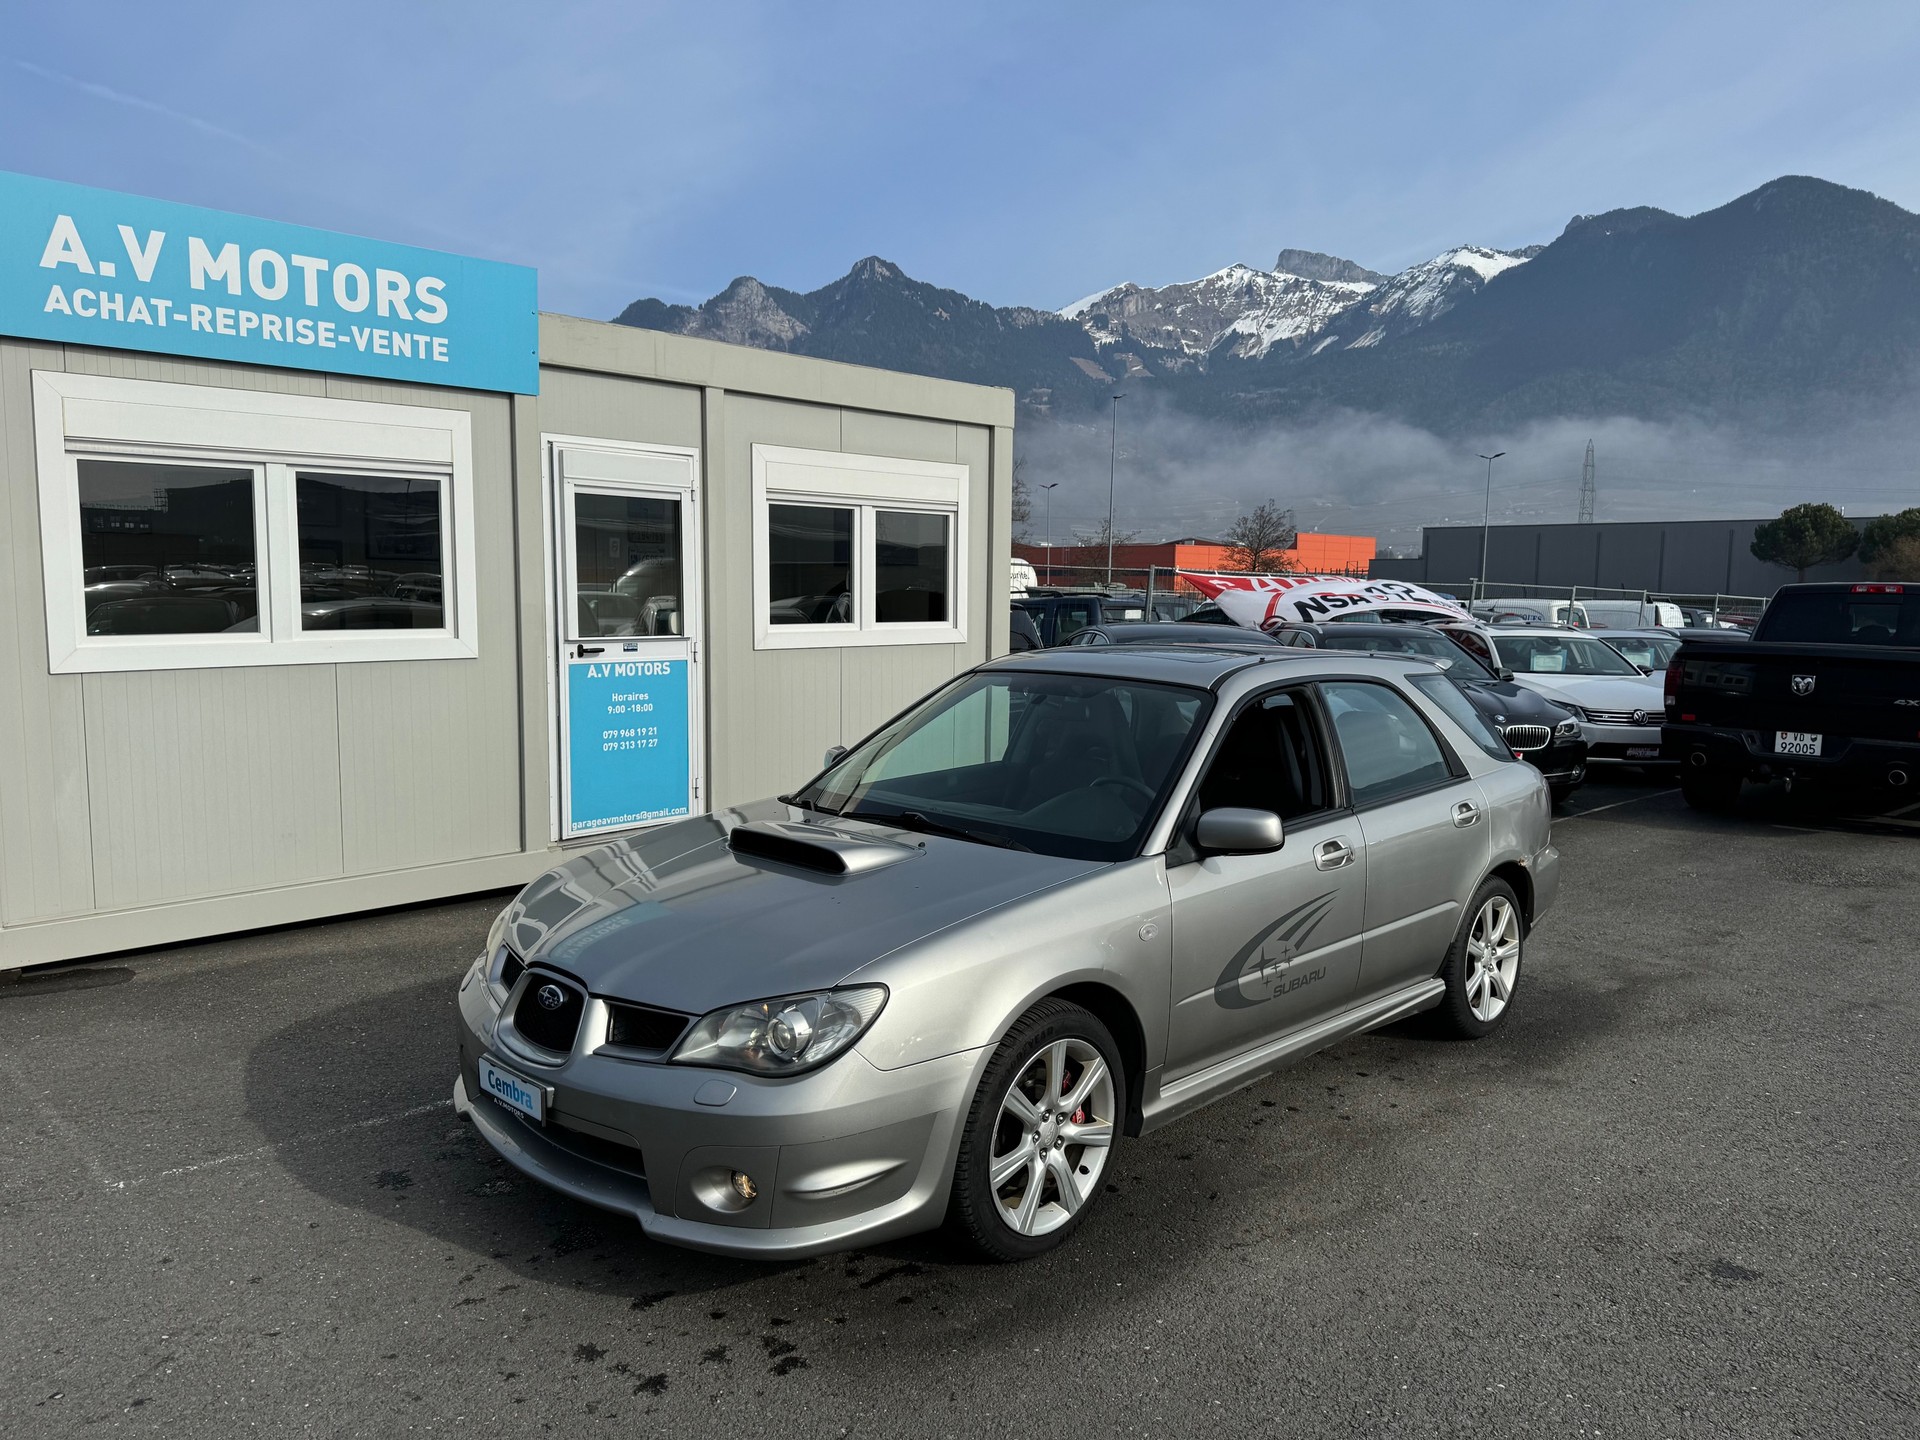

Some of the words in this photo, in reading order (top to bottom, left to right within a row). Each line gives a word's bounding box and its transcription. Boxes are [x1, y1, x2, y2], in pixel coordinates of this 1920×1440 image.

[39, 214, 166, 282] A.V
[188, 236, 449, 324] MOTORS
[43, 284, 450, 363] ACHAT-REPRISE-VENTE
[587, 664, 611, 678] A.V
[615, 662, 671, 677] MOTORS
[612, 692, 649, 702] Horaires
[607, 705, 626, 714] 9:00
[603, 730, 619, 739] 079
[620, 728, 635, 738] 968
[637, 728, 647, 736] 19
[648, 726, 657, 736] 21
[1793, 732, 1805, 742] VD
[603, 742, 619, 751] 079
[620, 740, 635, 750] 313
[637, 740, 647, 748] 17
[648, 738, 658, 748] 27
[1780, 741, 1816, 755] 92005
[572, 807, 688, 831] garageavmotors@gmail.com
[1273, 967, 1326, 998] SUBARU
[488, 1069, 533, 1110] Cembra
